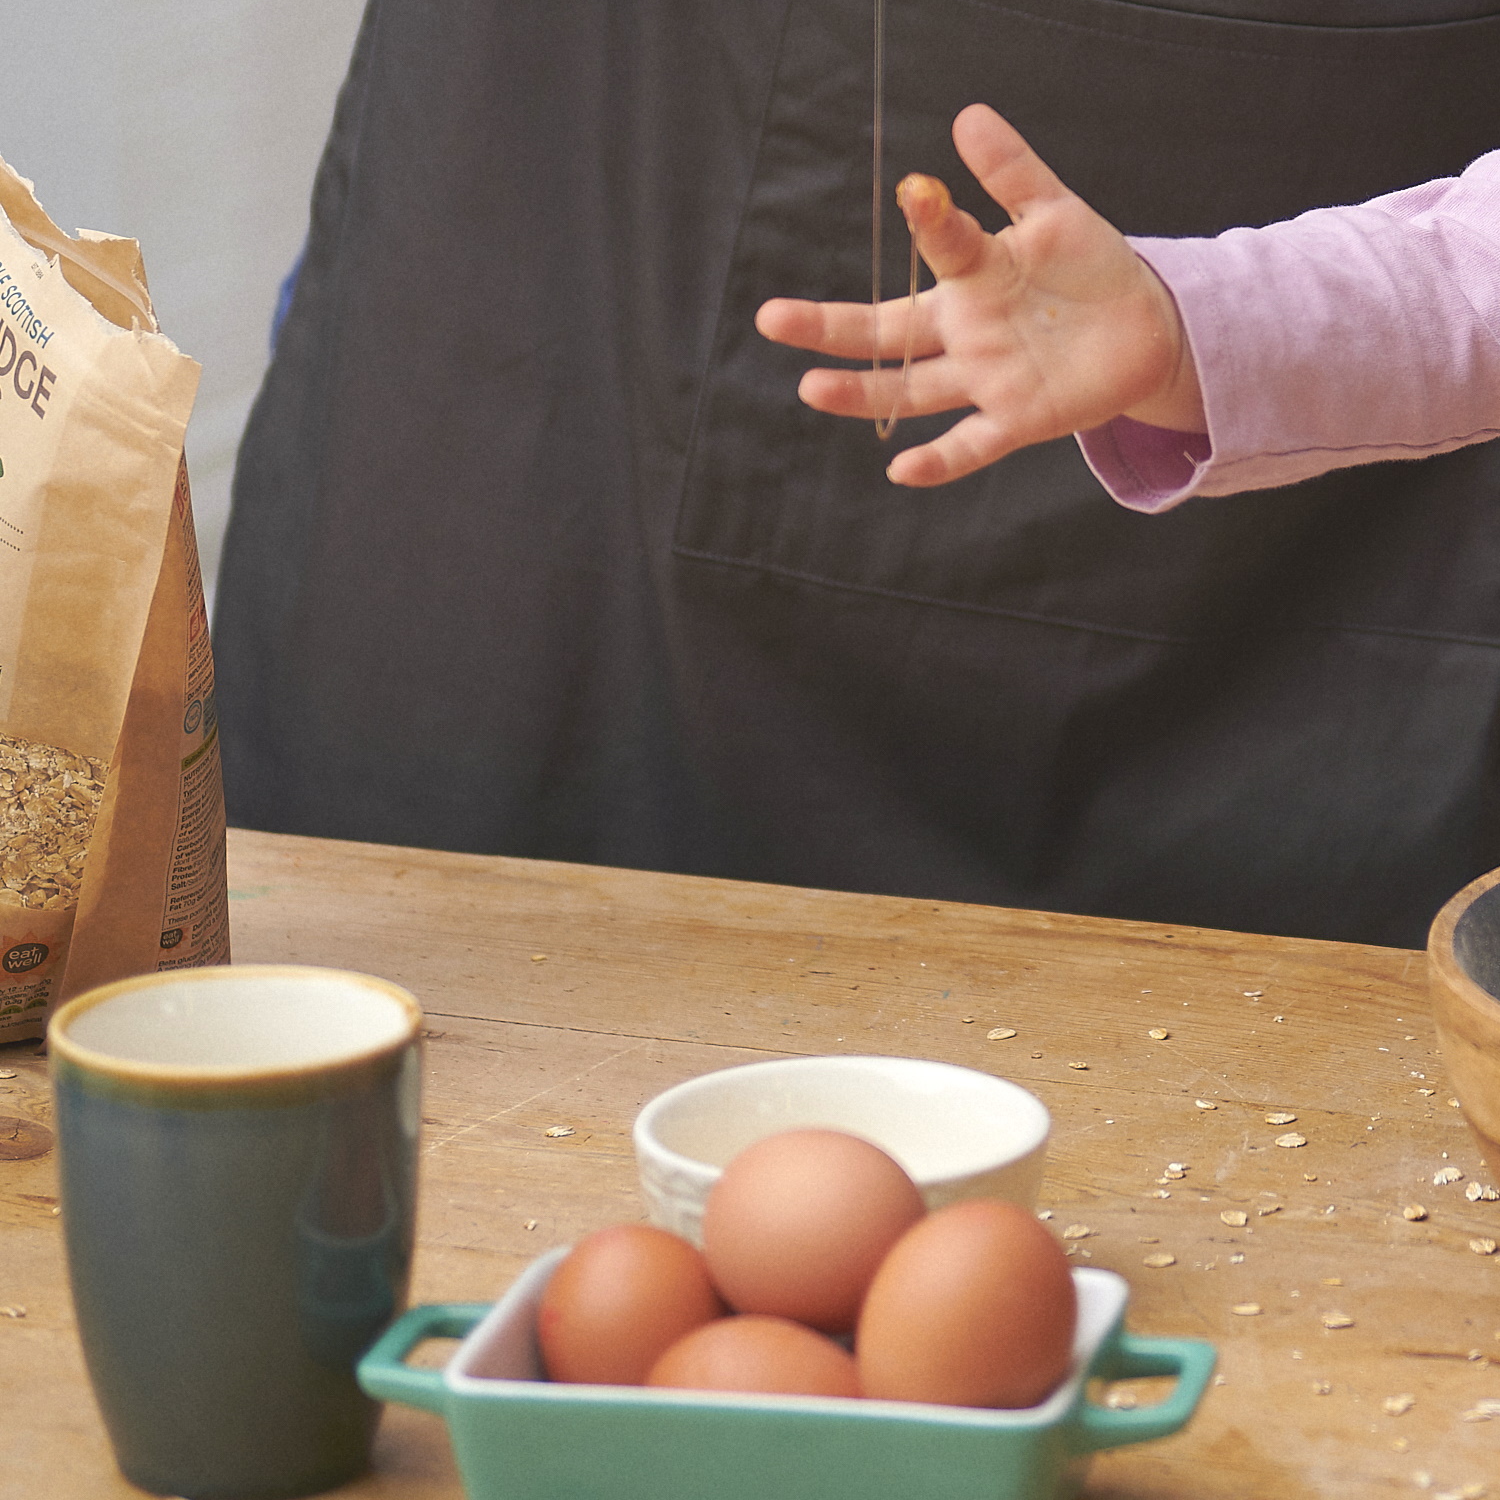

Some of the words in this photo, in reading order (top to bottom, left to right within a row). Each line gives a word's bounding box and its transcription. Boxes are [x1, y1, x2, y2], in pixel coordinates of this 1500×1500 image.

[1, 285, 54, 349] SCOTTISH
[0, 318, 57, 420] DGE
[8, 952, 42, 969] well
[9, 946, 39, 960] eat
